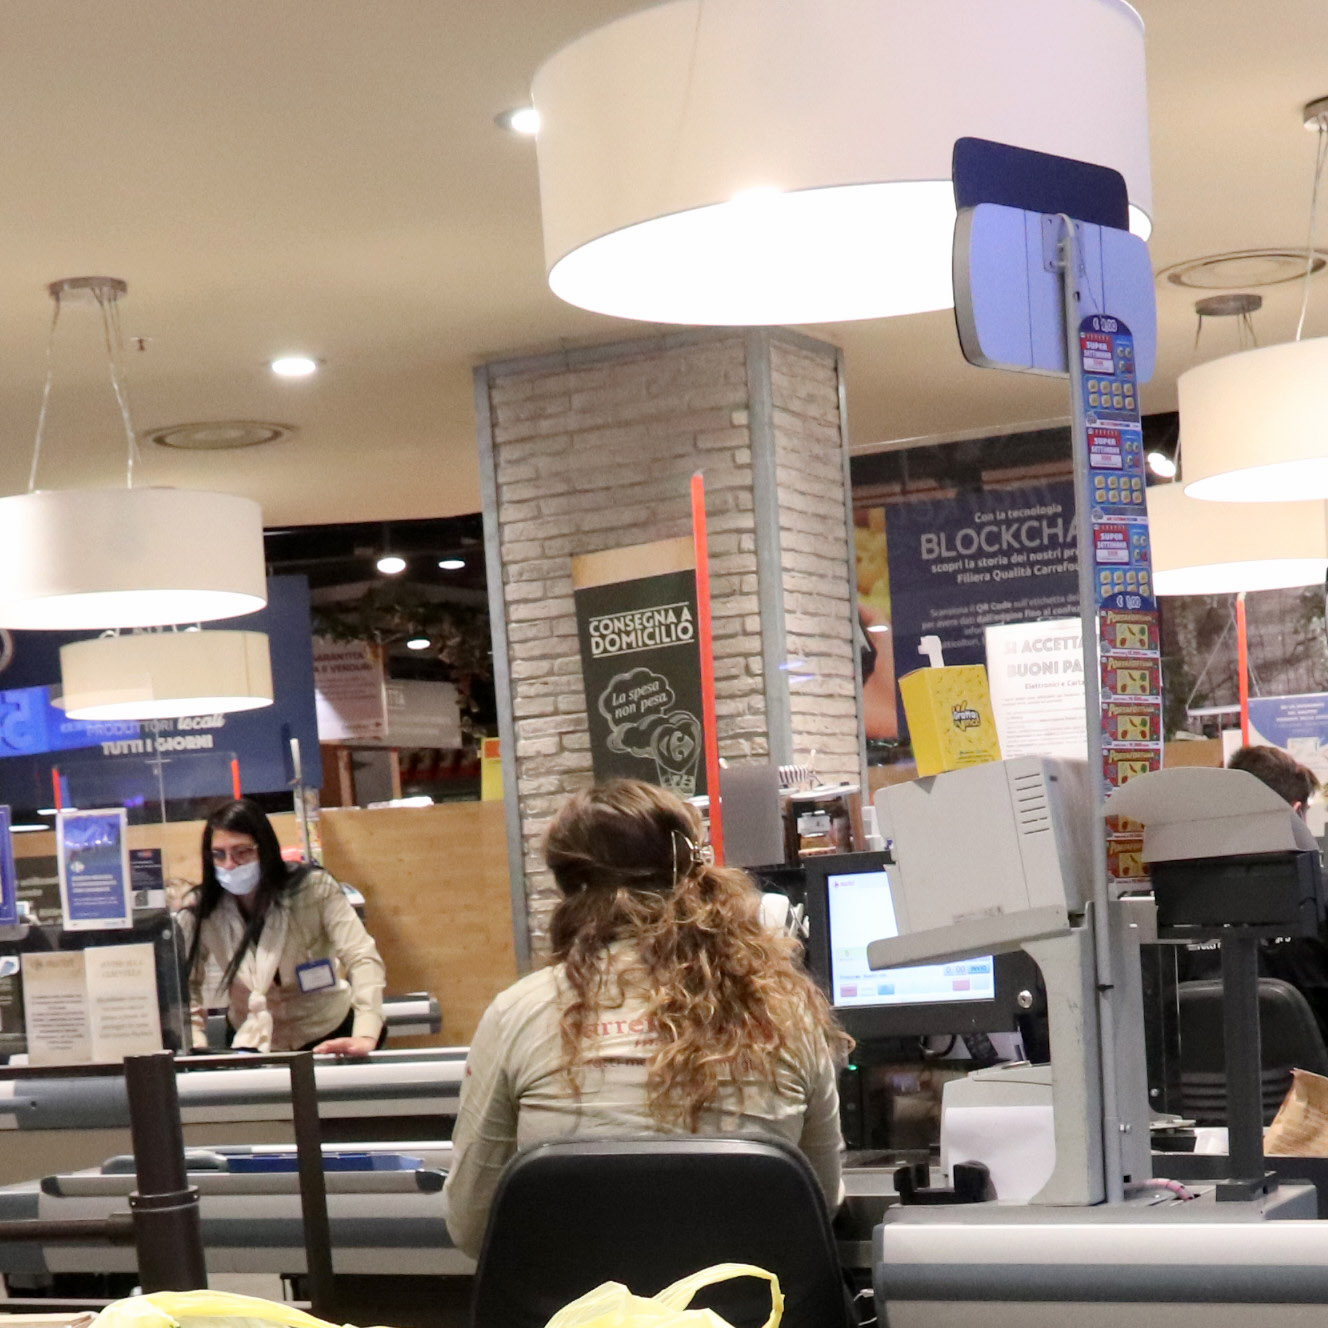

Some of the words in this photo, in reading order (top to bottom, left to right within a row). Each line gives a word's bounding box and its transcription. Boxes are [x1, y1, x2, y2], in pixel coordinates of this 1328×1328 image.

[974, 510, 994, 523] Con
[996, 508, 1006, 520] la
[1008, 503, 1063, 520] tecnologia
[1099, 532, 1124, 541] SUPER
[931, 558, 963, 574] scopri
[965, 556, 976, 569] la
[977, 553, 1009, 568] storia
[1010, 551, 1028, 564] dei
[1029, 547, 1062, 563] nostri
[956, 570, 991, 585] Filiera
[992, 565, 1032, 583] Qualità
[589, 608, 677, 637] CONSEGNA
[680, 605, 693, 622] A
[590, 621, 694, 655] DOMICILIO
[1007, 660, 1060, 679] BUONI
[612, 690, 628, 707] La
[628, 680, 660, 702] spesa
[615, 703, 637, 720] non
[640, 690, 668, 714] pesa
[100, 740, 145, 757] TUTTI
[155, 734, 213, 753] GIORNI
